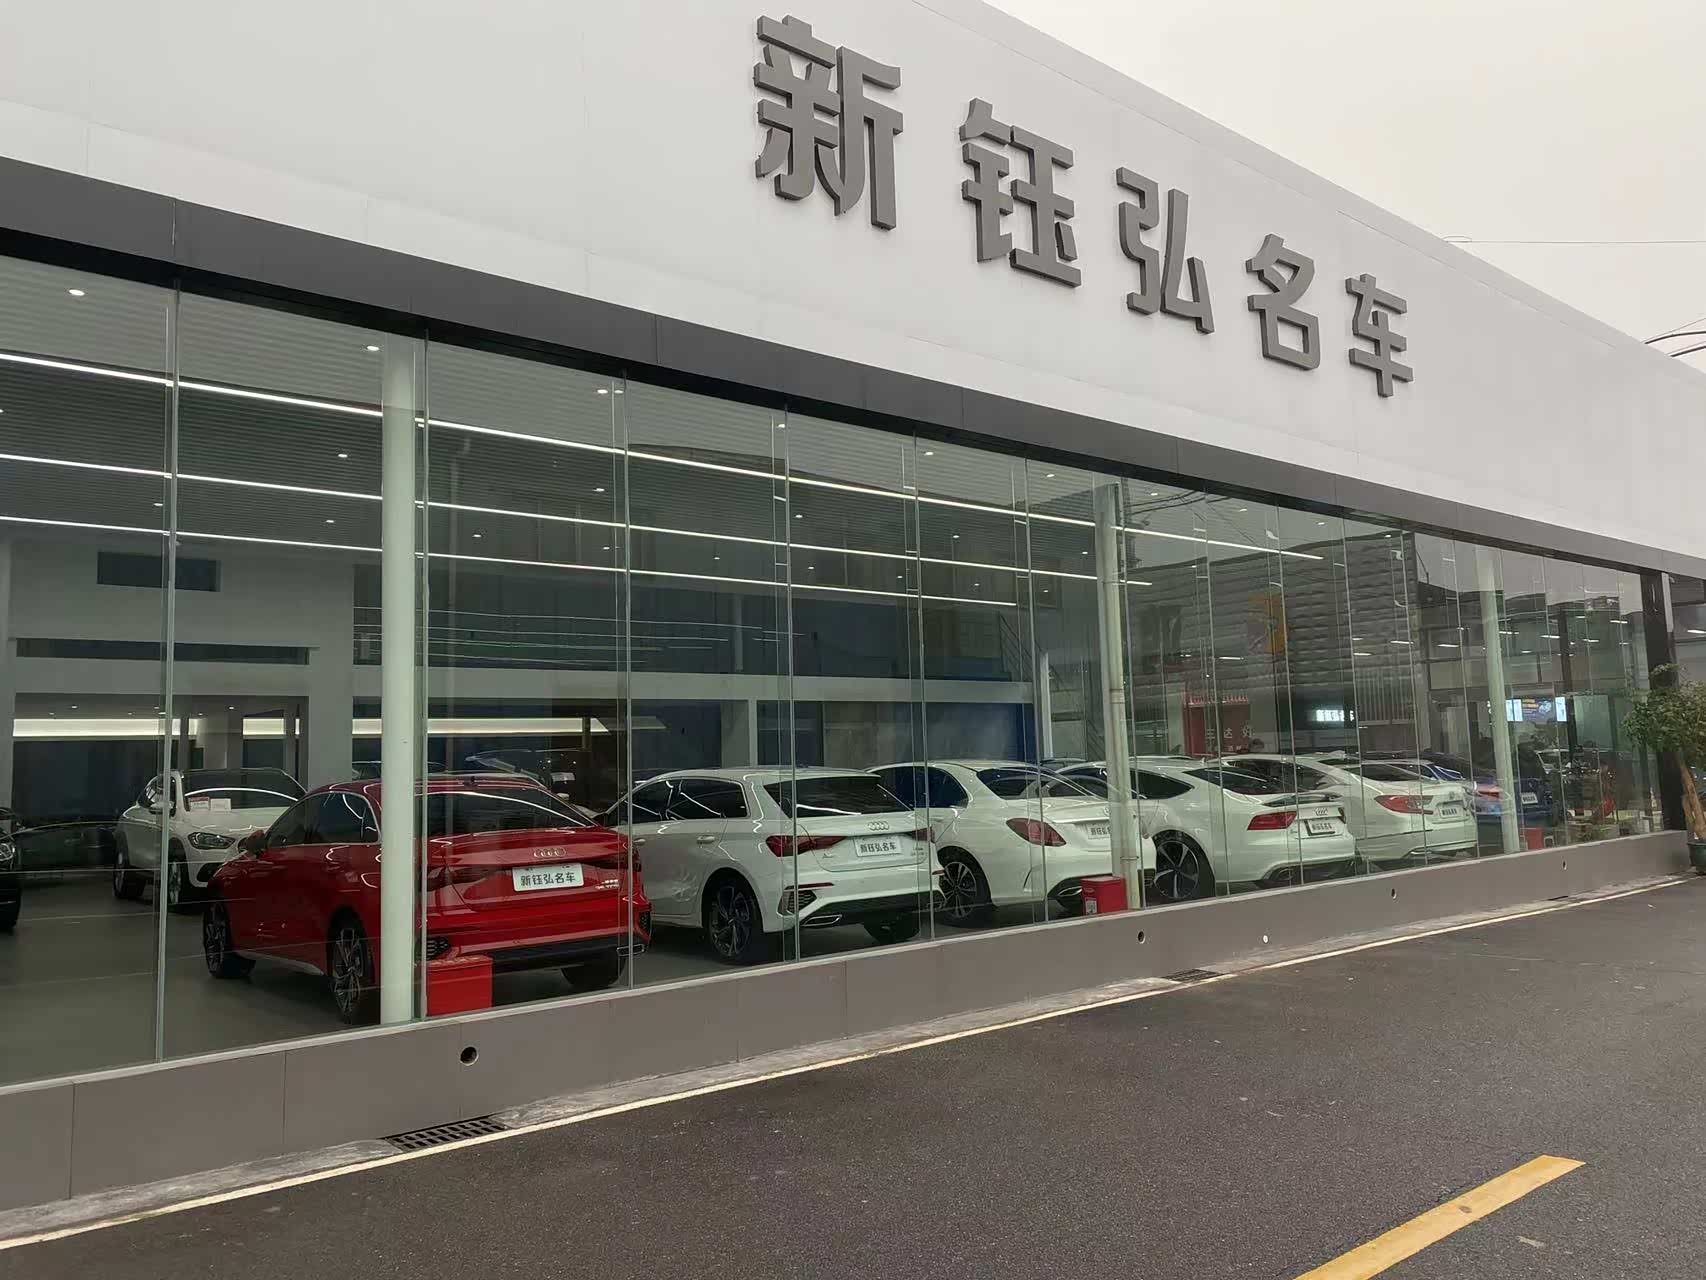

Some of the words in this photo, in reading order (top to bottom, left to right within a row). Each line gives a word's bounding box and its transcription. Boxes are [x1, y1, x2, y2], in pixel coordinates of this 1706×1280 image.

[754, 15, 1413, 397] 新钰弘名车
[520, 871, 576, 887] 新钰弘名车
